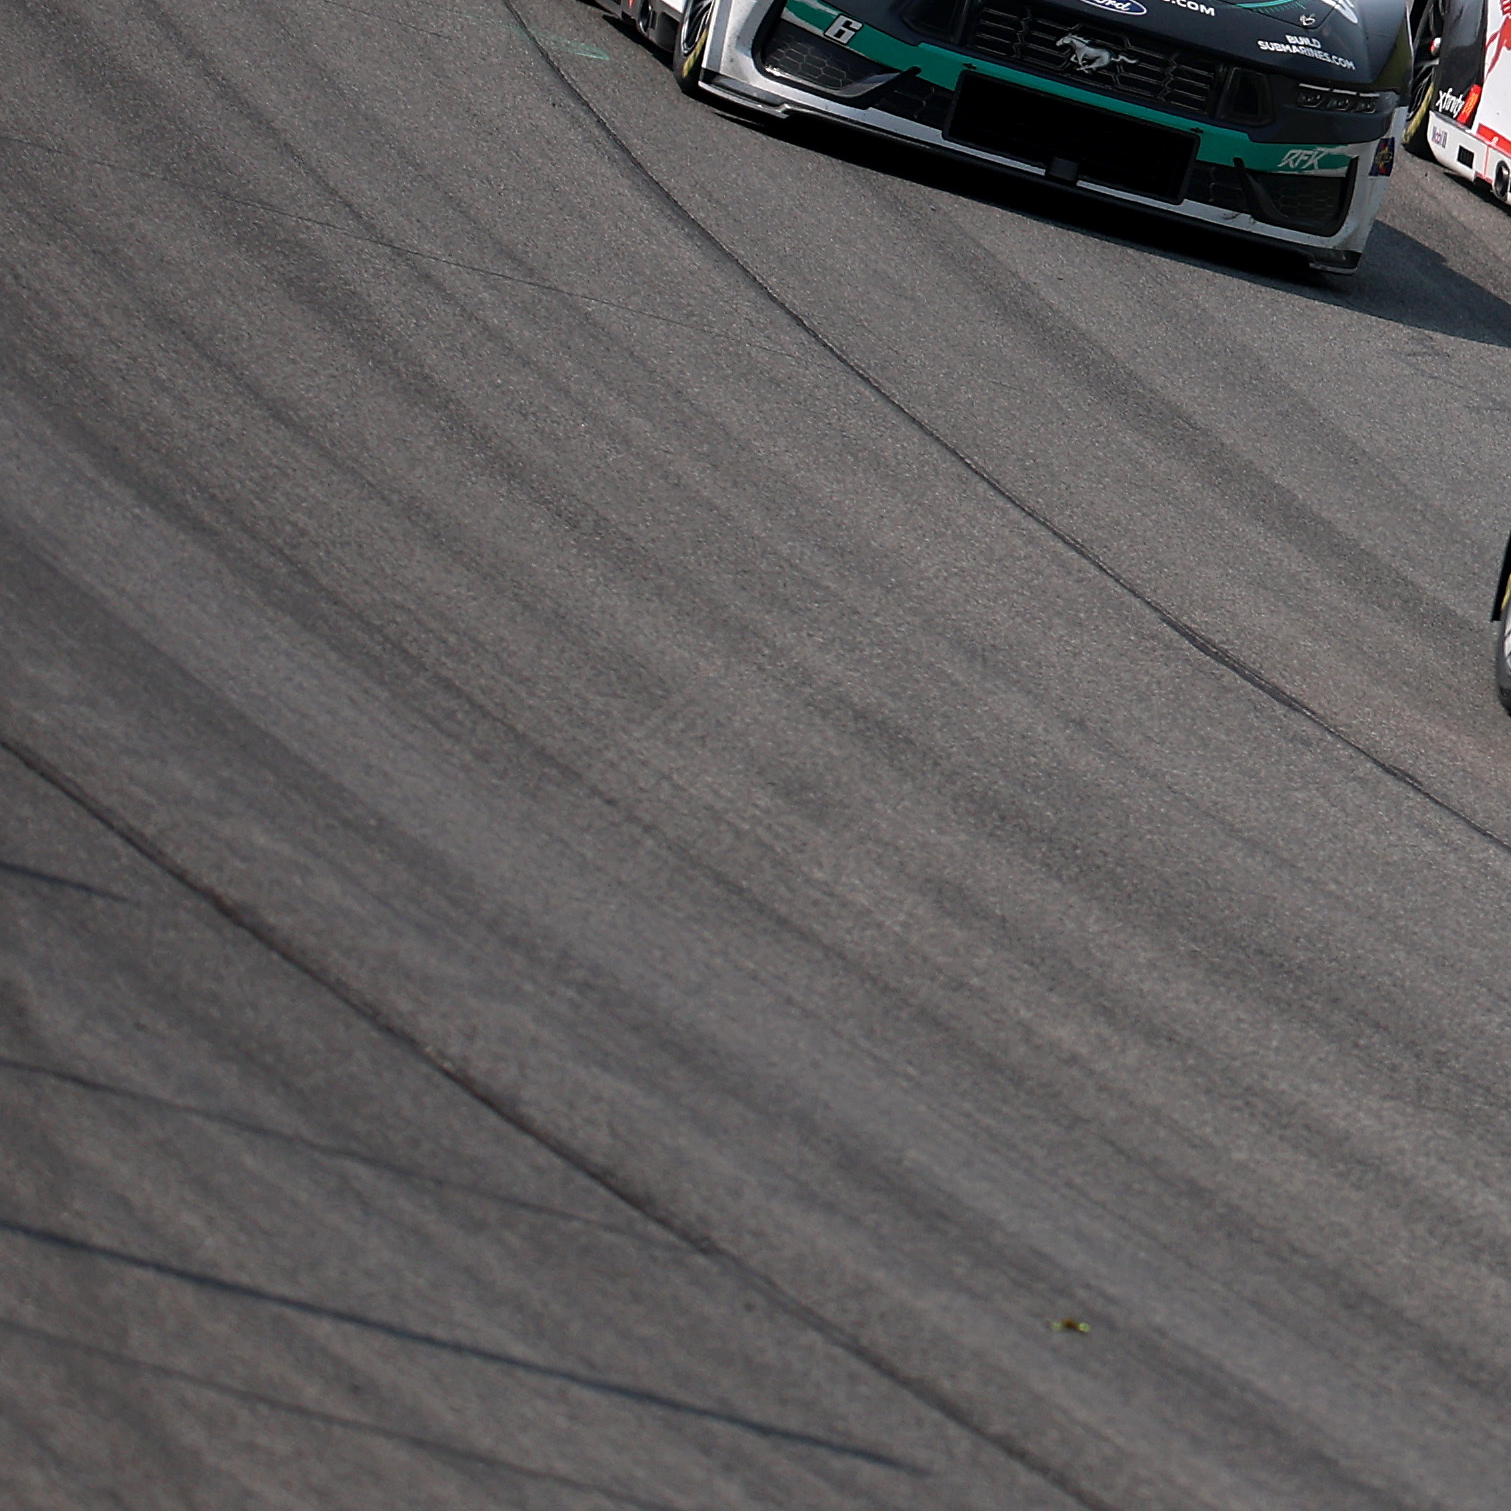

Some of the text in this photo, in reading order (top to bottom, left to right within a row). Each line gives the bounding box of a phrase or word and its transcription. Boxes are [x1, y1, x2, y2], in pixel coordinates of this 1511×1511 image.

[828, 15, 861, 44] 6
[1286, 33, 1322, 51] BUILD
[1257, 39, 1356, 72] SUBMARINES.COM
[1435, 87, 1466, 120] xfinity
